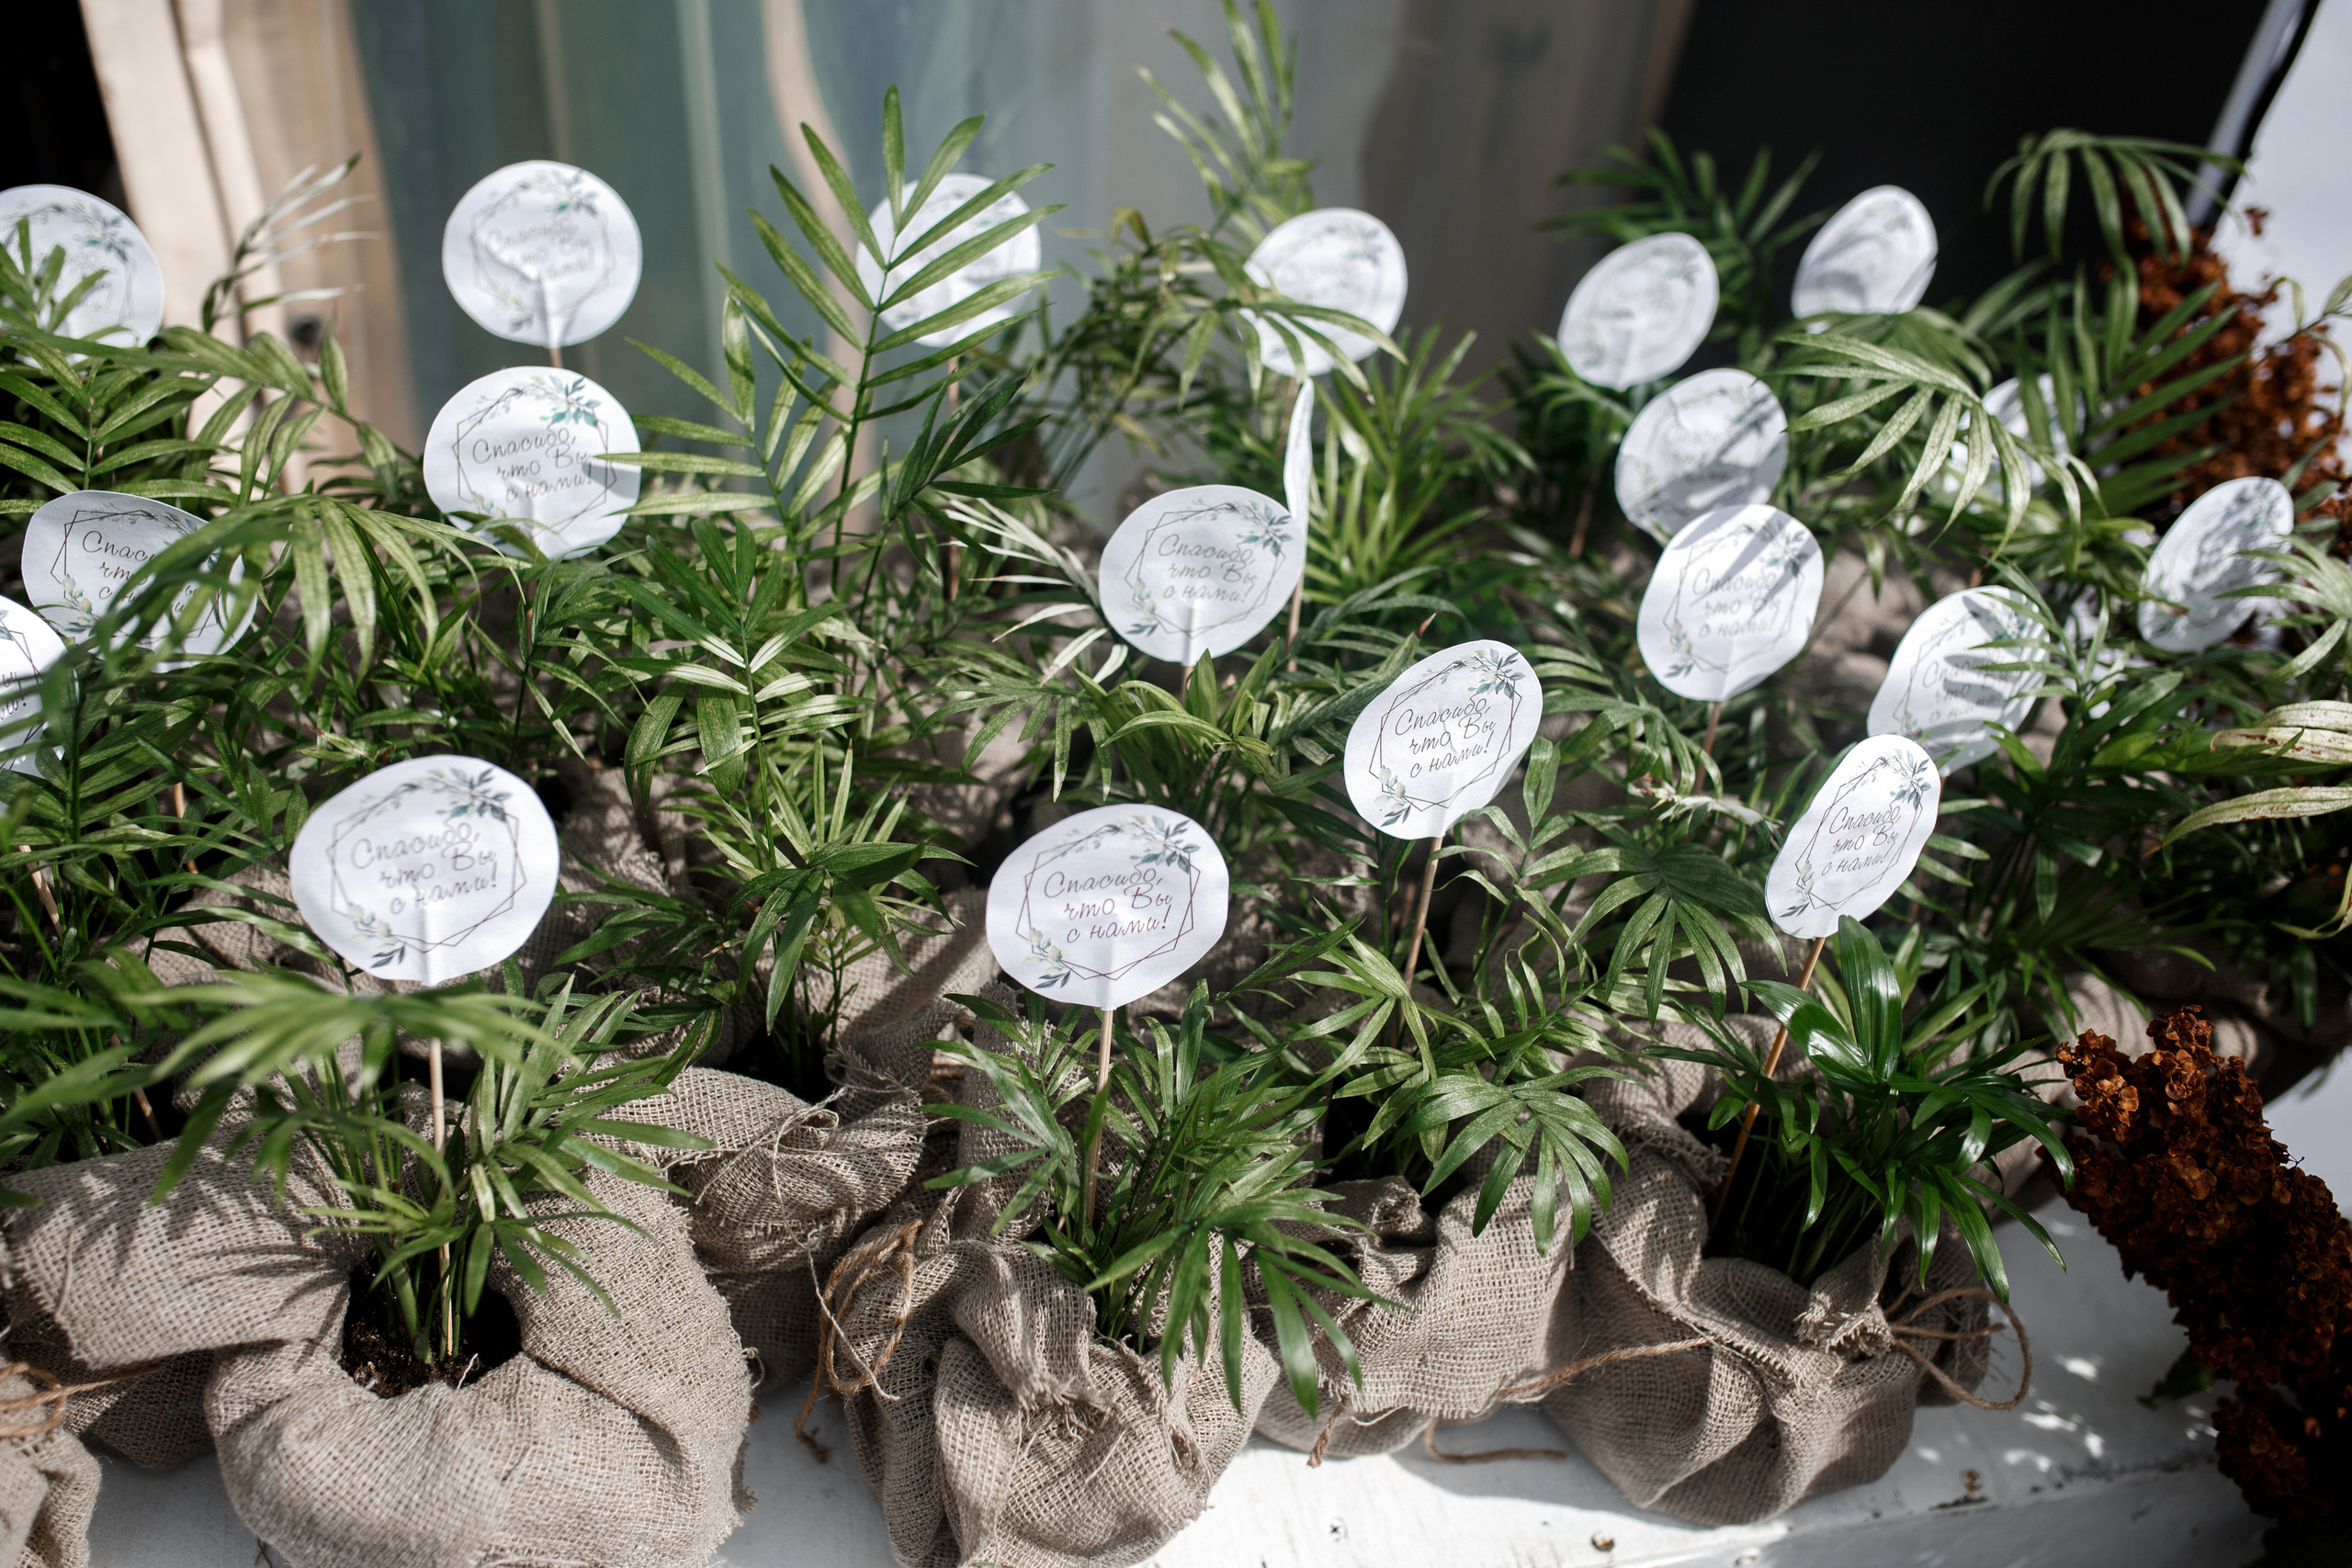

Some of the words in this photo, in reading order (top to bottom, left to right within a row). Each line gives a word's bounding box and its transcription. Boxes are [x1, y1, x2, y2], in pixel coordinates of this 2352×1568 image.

[473, 422, 577, 464] Спасибо,
[497, 459, 541, 480] что
[545, 443, 592, 469] Вы
[506, 487, 518, 504] с
[526, 461, 593, 499] нами!
[1158, 533, 1257, 566] Спасибо,
[1168, 562, 1212, 580] что
[1220, 559, 1260, 585] Вы
[1162, 585, 1177, 599] с
[1182, 583, 1256, 604] нами!
[1395, 692, 1491, 736] Спасибо,
[1408, 731, 1452, 755] что
[1458, 712, 1497, 739] Вы
[1409, 762, 1423, 779] с
[1429, 729, 1495, 773] нами!
[1828, 798, 1902, 835] Спасибо,
[350, 815, 481, 869] Спасибо,
[1832, 834, 1865, 855] что
[1872, 820, 1900, 847] Вы
[379, 863, 435, 888] что
[440, 840, 497, 871] Вы
[1821, 861, 1833, 876] с
[1836, 840, 1896, 873] нами!
[390, 897, 406, 915] с
[415, 861, 498, 908] нами!
[1044, 862, 1164, 898] Спасибо,
[1064, 897, 1115, 920] что
[1123, 882, 1173, 909] Вы
[1067, 928, 1080, 944] с
[1089, 904, 1172, 940] нами!
